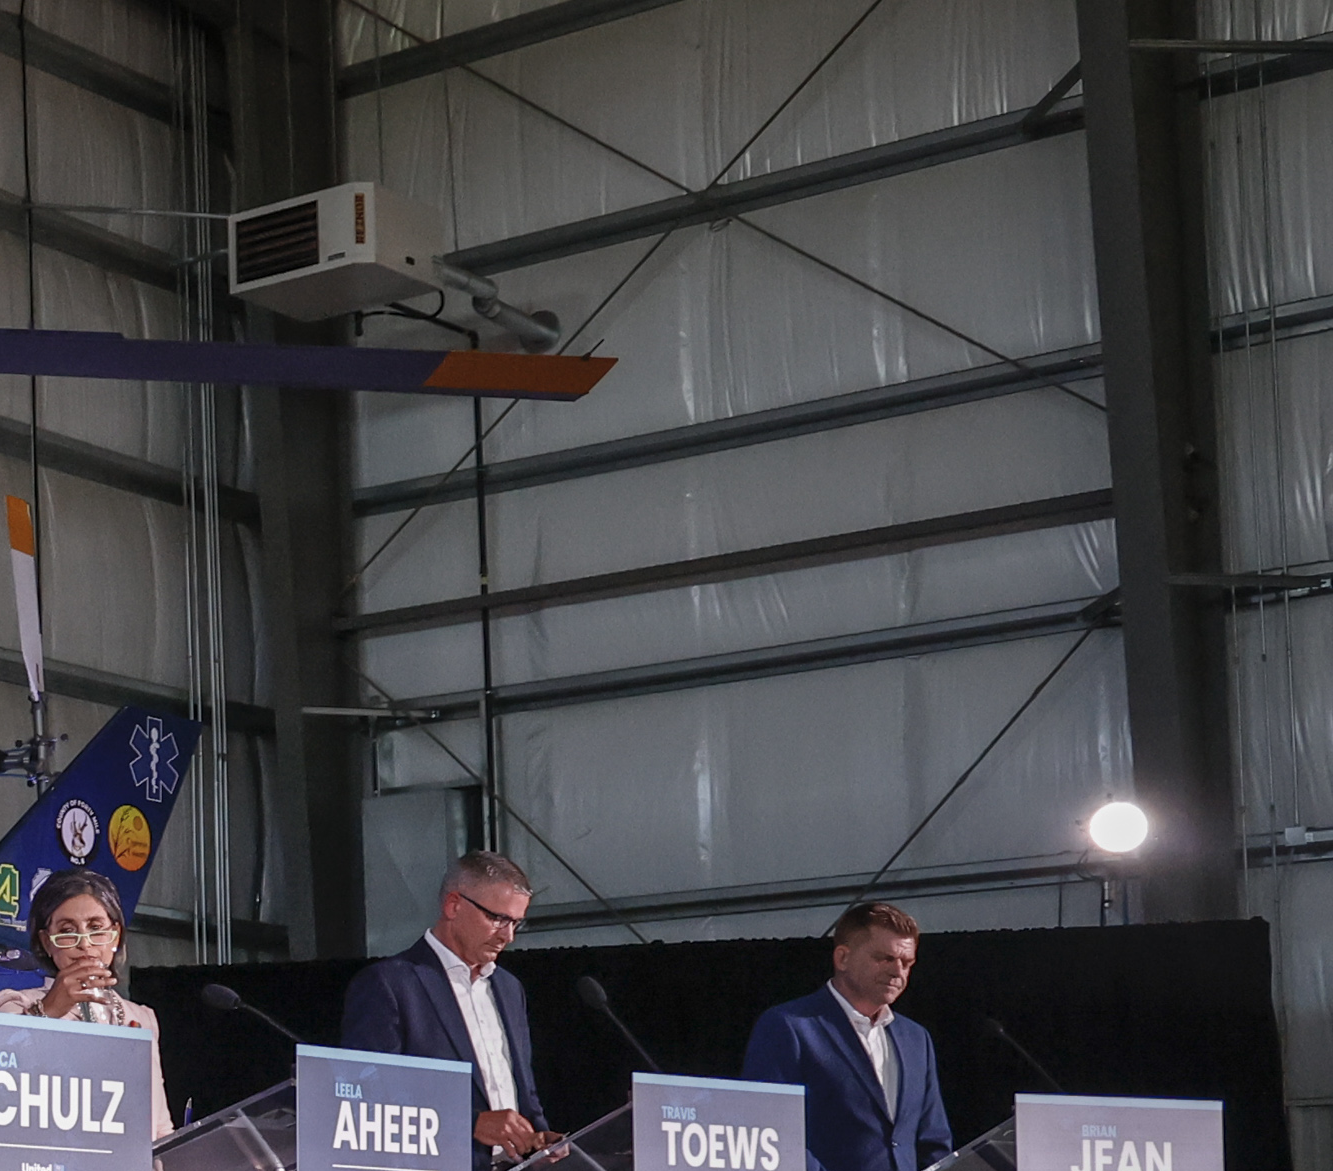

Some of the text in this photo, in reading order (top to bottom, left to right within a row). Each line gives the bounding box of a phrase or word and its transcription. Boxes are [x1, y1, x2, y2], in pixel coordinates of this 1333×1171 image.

[335, 1082, 362, 1099] LEELA
[661, 1105, 696, 1121] TRAVIS
[333, 1100, 439, 1156] AHEER
[1081, 1124, 1117, 1138] BRIAN
[661, 1121, 780, 1171] TOEWS
